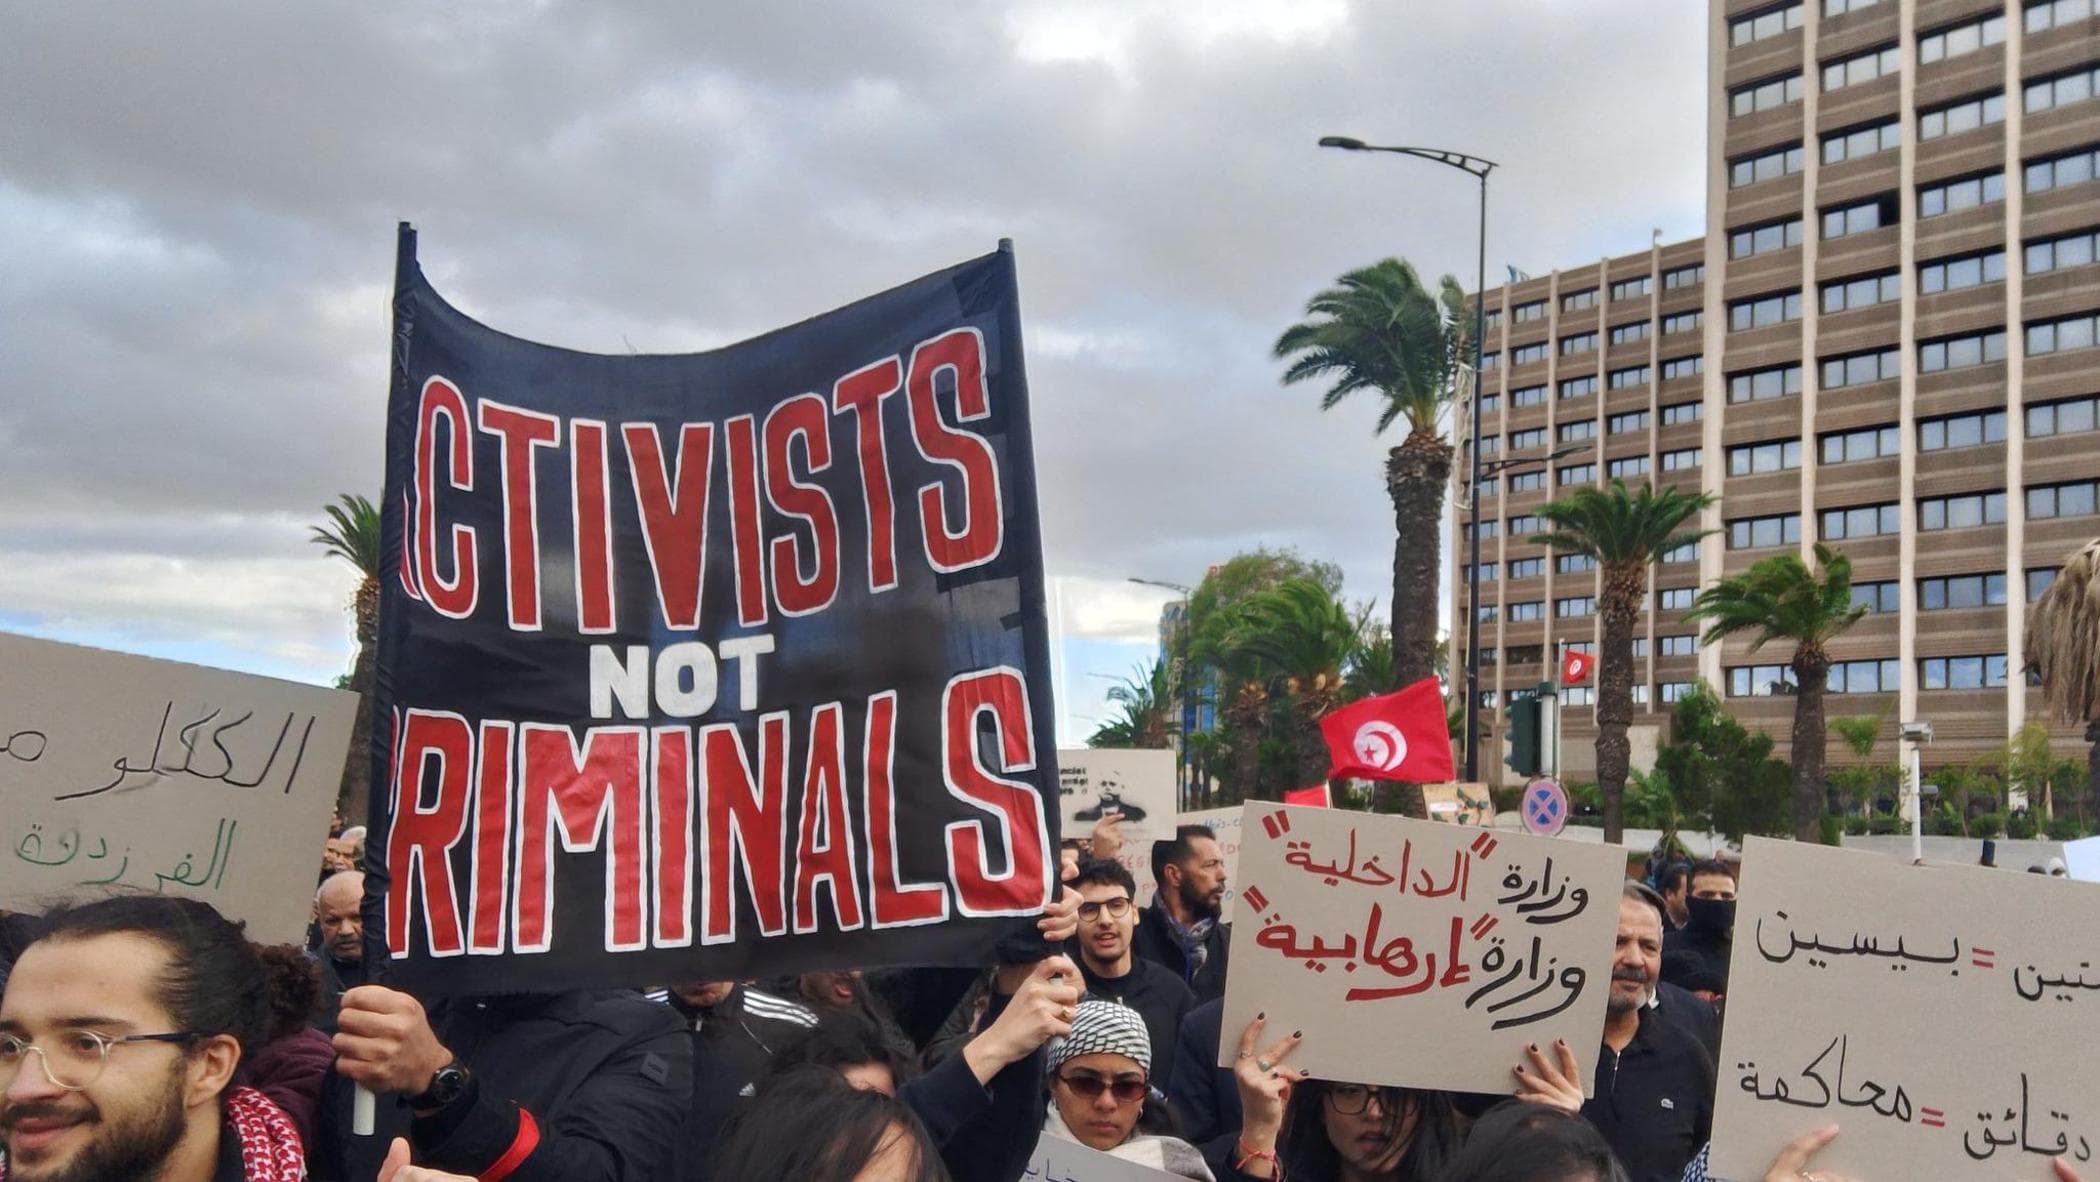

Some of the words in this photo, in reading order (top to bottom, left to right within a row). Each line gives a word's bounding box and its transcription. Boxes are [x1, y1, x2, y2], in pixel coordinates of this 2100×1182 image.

[400, 327, 1003, 633] CTIVISTS
[589, 633, 775, 719] NOT
[387, 665, 1053, 959] RIMINALS
[1497, 857, 1589, 924] وزارة
[1465, 936, 1586, 1031] وزارة
[1972, 947, 1995, 968] =
[1737, 1033, 1913, 1123] محاكمة
[1920, 1106, 1945, 1127] =
[1963, 1072, 2091, 1162] دقائق
